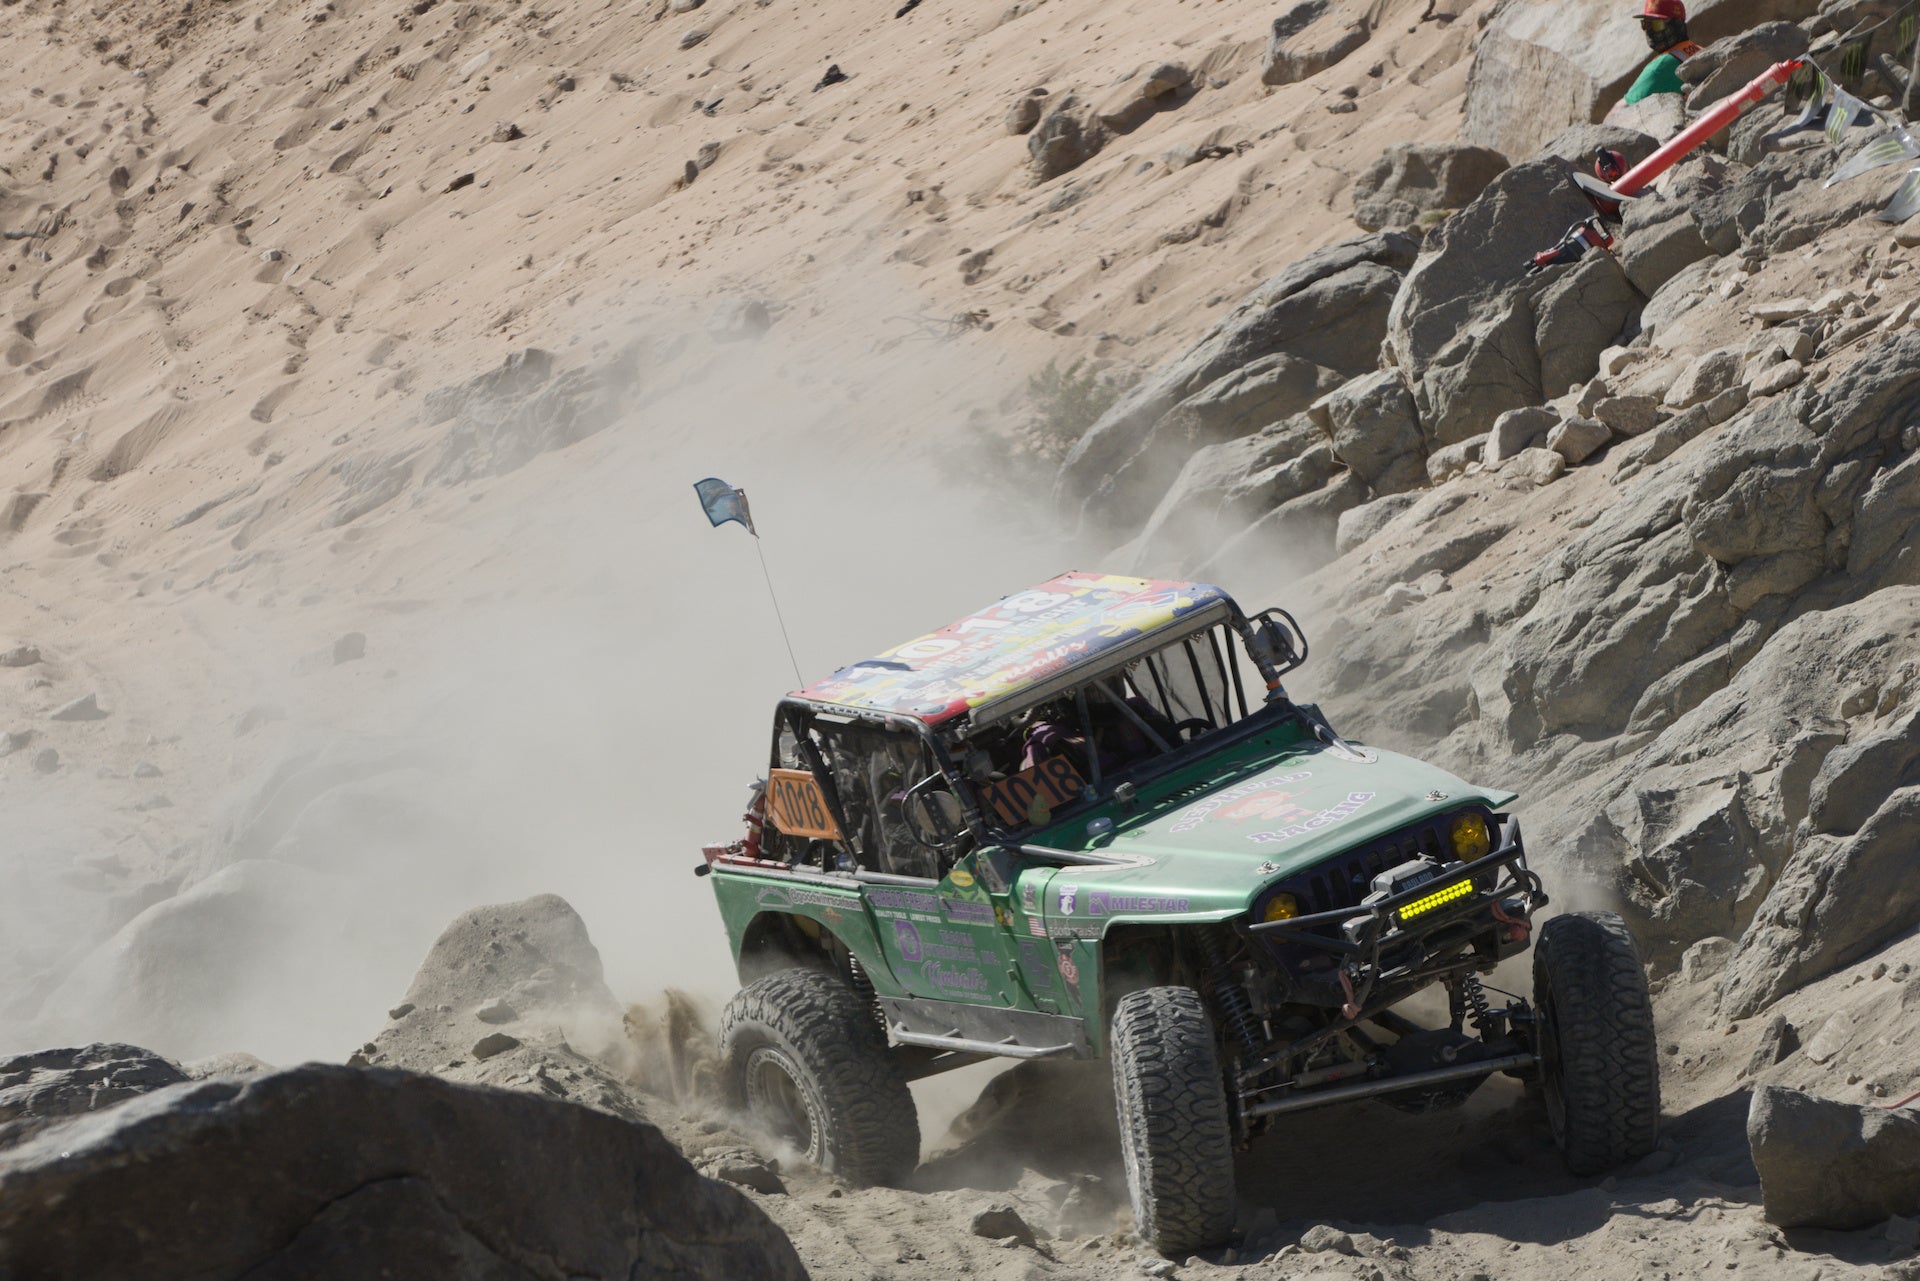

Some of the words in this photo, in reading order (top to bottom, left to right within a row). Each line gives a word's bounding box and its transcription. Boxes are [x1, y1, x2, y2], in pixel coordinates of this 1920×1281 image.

[846, 591, 1073, 681] 1018
[776, 780, 826, 830] 1018
[991, 758, 1085, 822] 1018
[1246, 791, 1377, 843] RACING
[1111, 896, 1190, 913] MILESTAR
